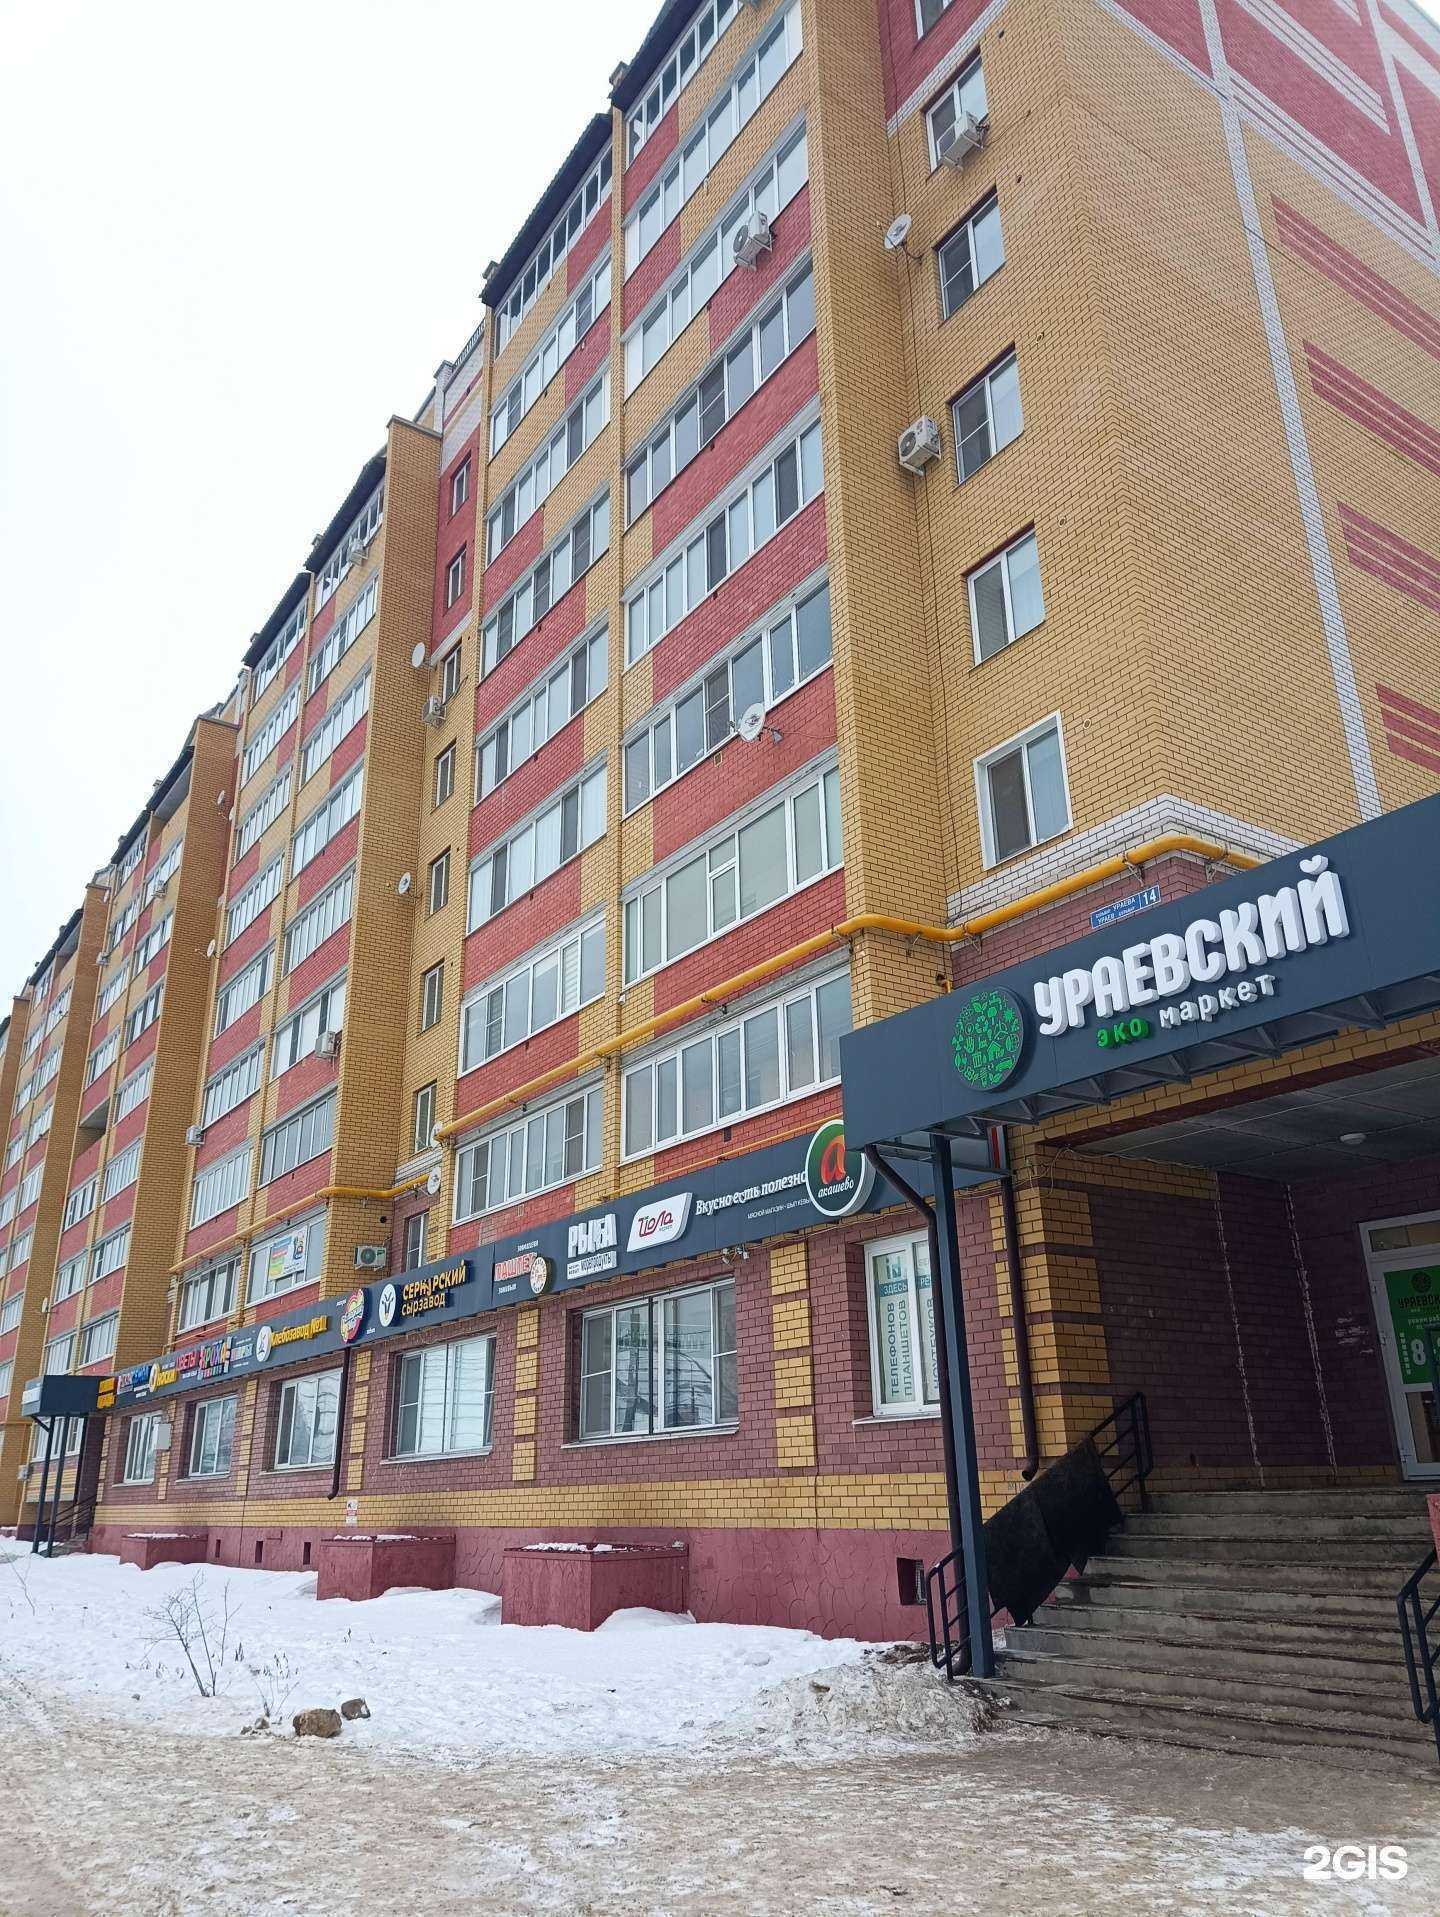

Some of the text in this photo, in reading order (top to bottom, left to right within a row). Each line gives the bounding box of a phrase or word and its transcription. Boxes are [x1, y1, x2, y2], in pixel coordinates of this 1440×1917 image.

[1143, 888, 1157, 905] 14
[1033, 854, 1350, 1037] УРАЕВСКИЙ
[1159, 974, 1276, 1030] маркет
[817, 1175, 855, 1198] акашево
[695, 1193, 733, 1216] Вкусно
[402, 1259, 466, 1301] СЕРНУРСКИЙ
[883, 1281, 908, 1295] ЗДЕСЬ
[400, 1292, 446, 1318] сырзавод
[887, 1302, 900, 1397] ТЕЛЕФОНОВ
[898, 1299, 913, 1396] ПЛАНШЕТОВ
